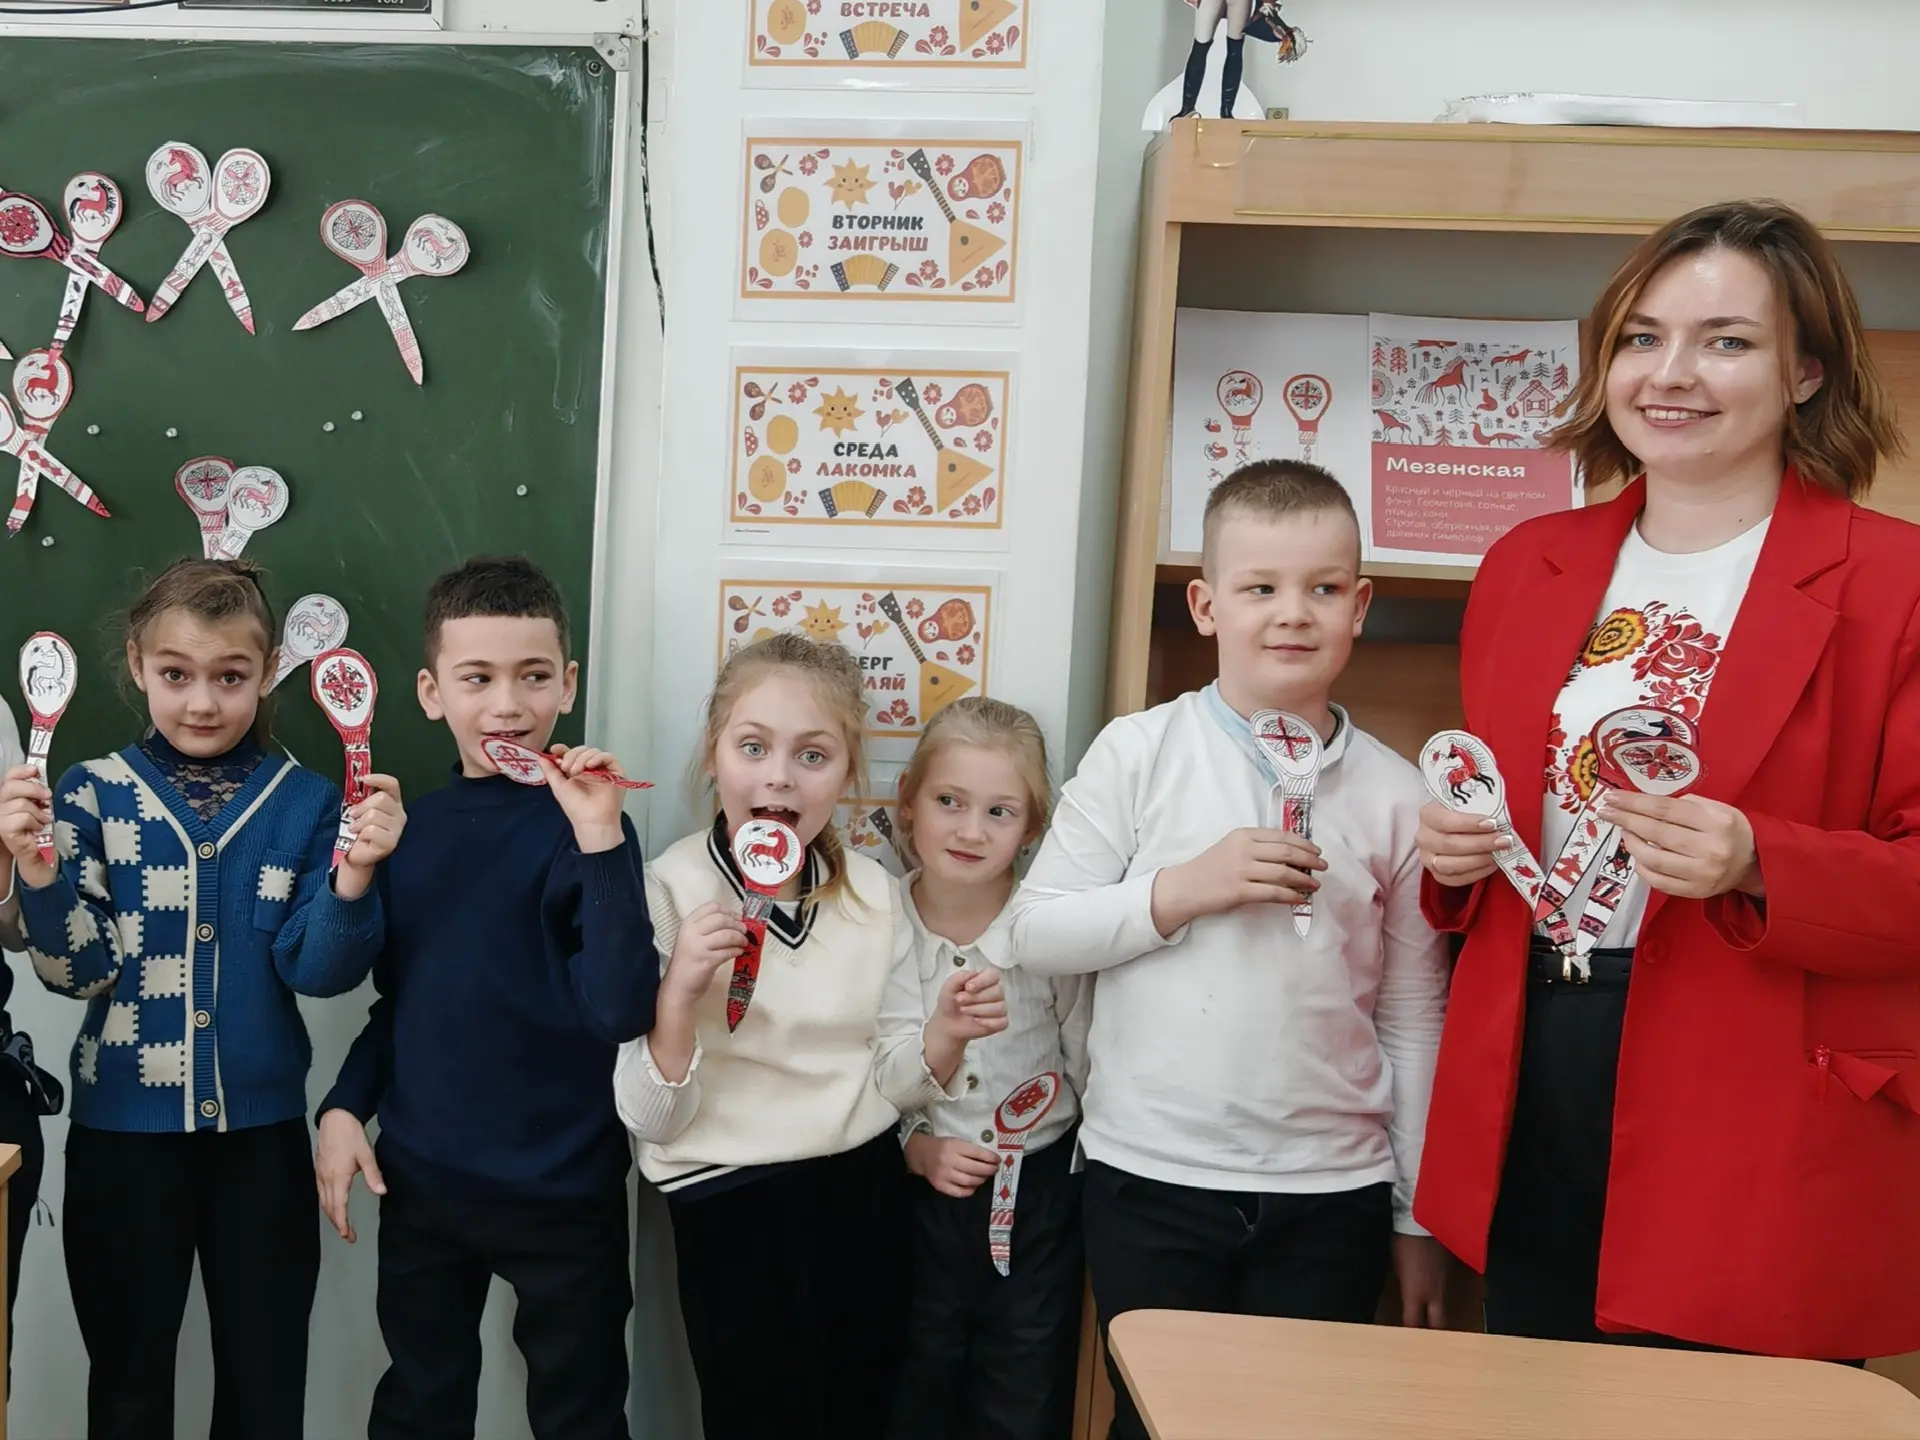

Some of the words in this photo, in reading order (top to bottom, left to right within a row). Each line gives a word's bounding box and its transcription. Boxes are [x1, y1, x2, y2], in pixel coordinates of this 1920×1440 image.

[840, 2, 931, 18] ВСТРЕЧА
[832, 215, 924, 231] ВТОРНИК
[827, 235, 929, 252] ЗАИГРЫШ
[833, 442, 899, 460] СРЕДА
[816, 462, 917, 479] ЛАКОМКА
[1386, 456, 1526, 478] Мезенская
